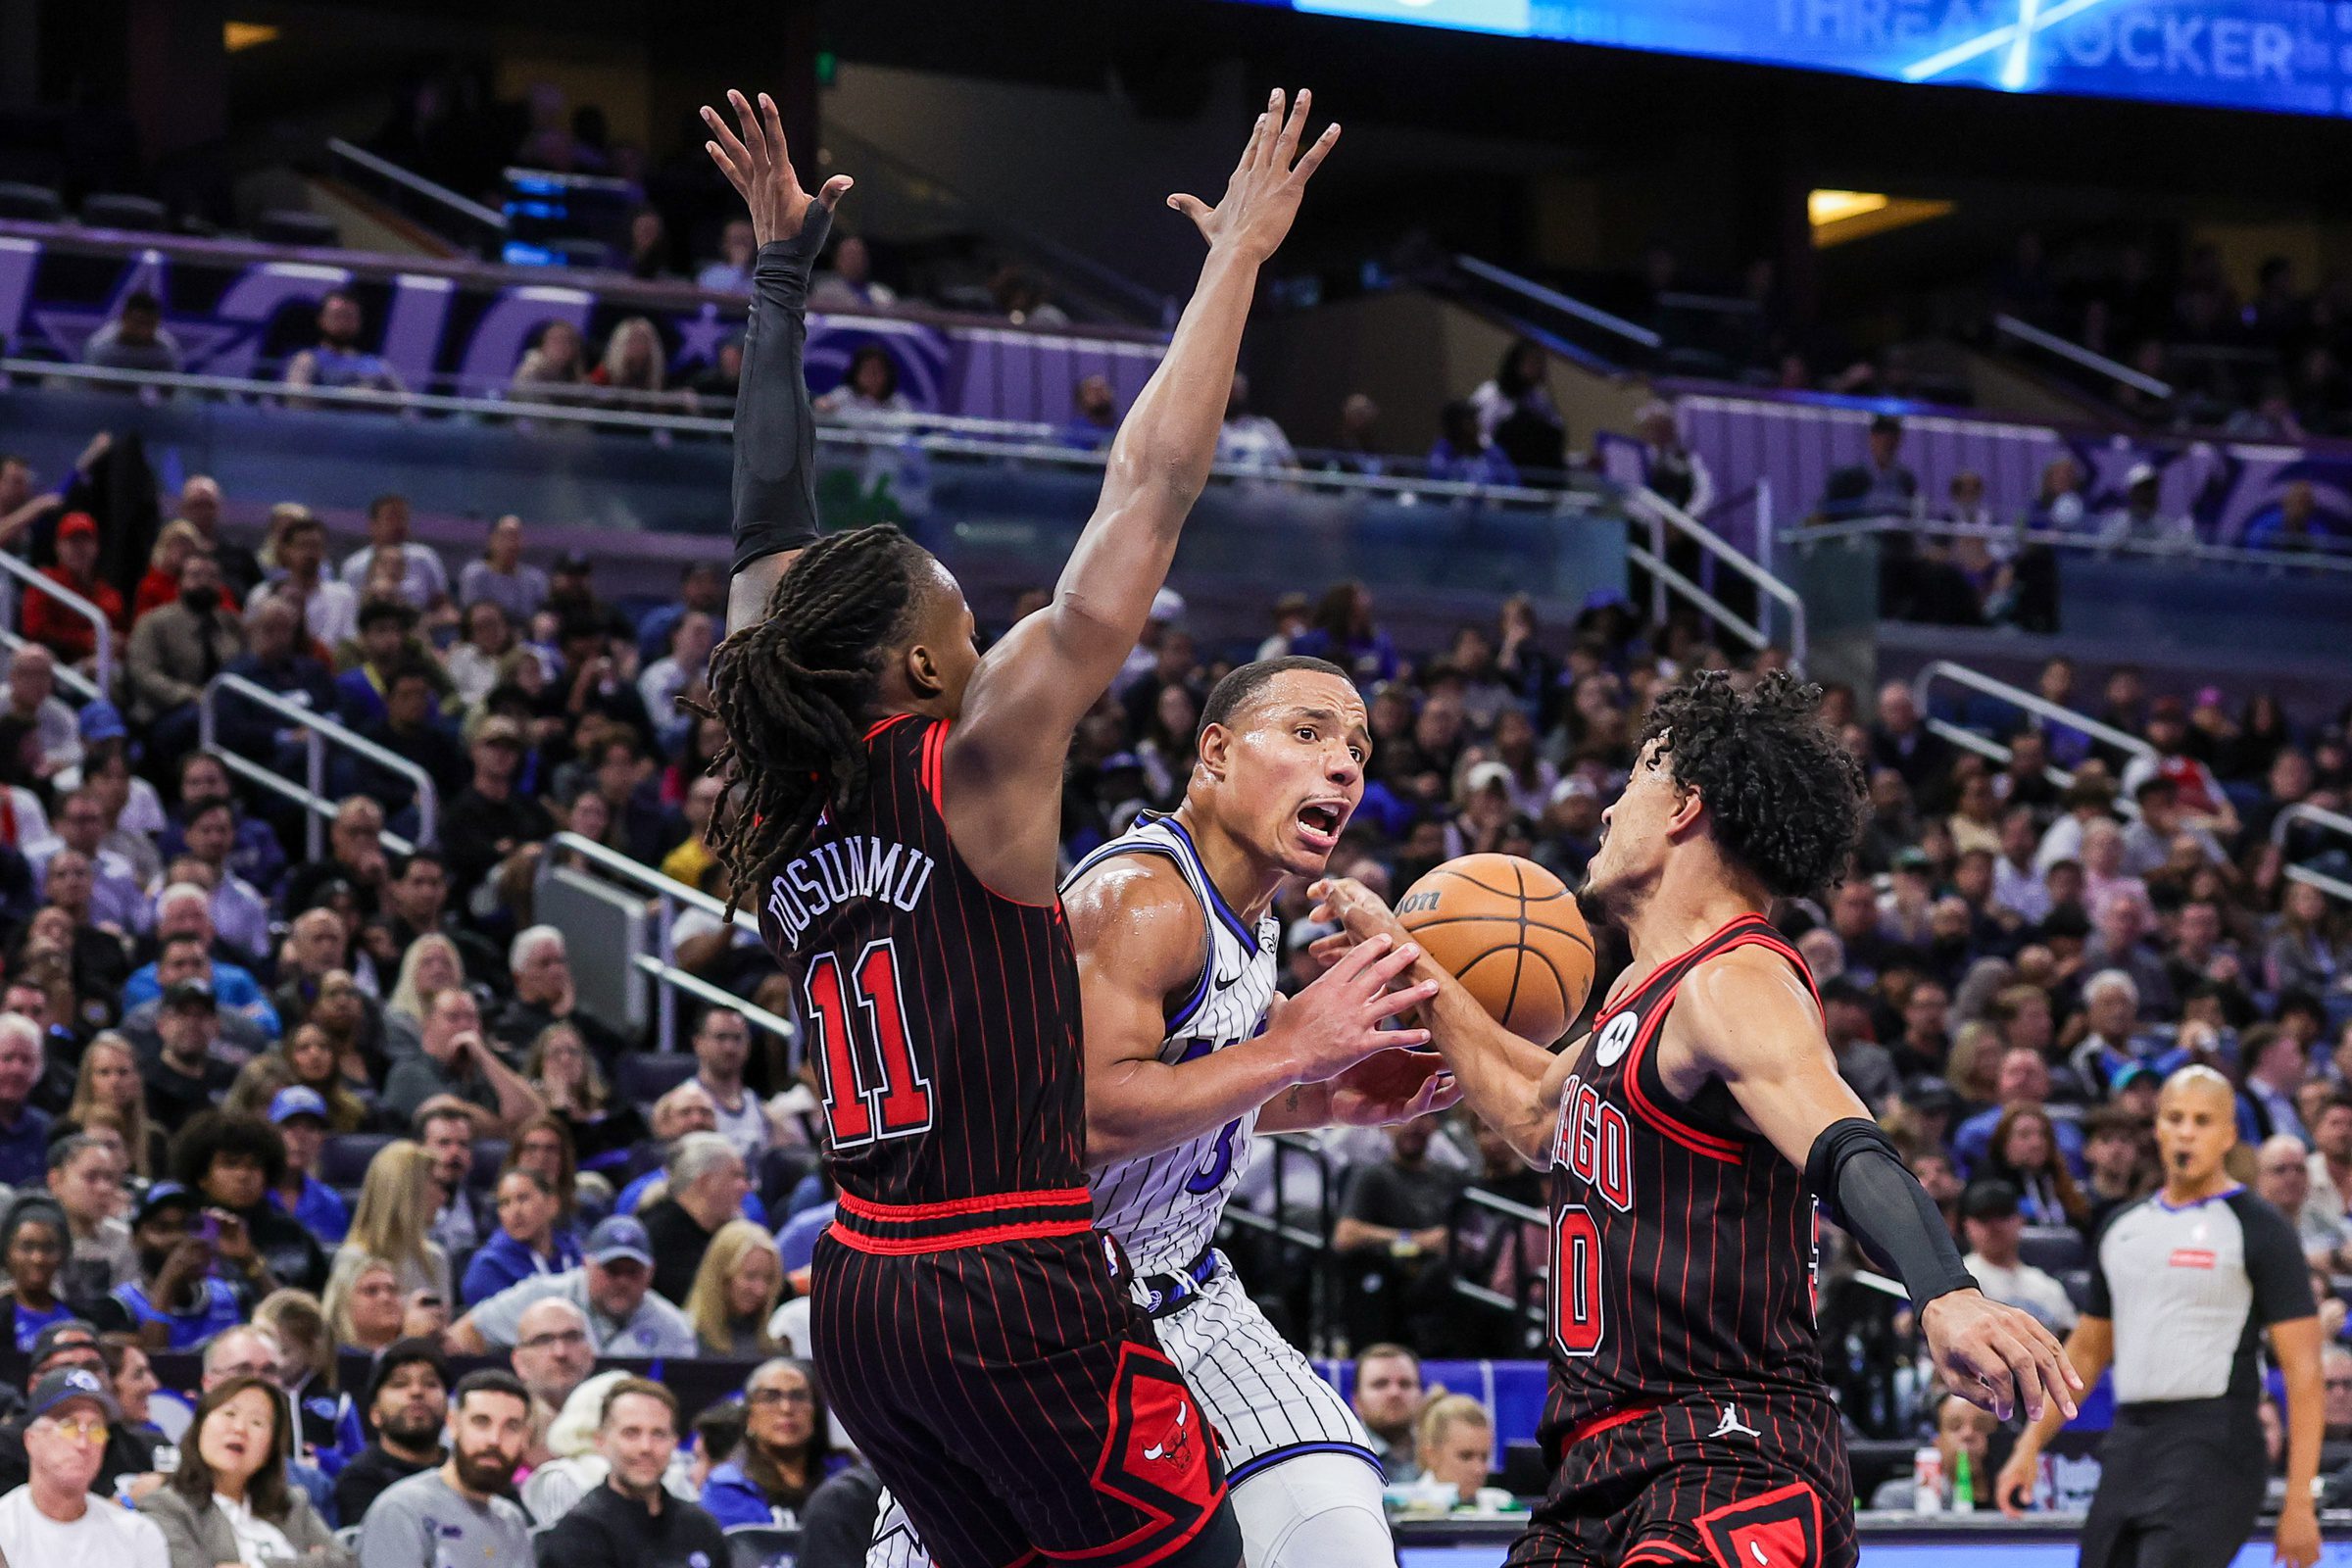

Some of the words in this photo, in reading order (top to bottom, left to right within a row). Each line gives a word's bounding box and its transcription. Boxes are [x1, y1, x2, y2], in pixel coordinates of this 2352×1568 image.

[767, 836, 934, 951] DOSUNMU
[804, 937, 933, 1150] 11
[1546, 1203, 1604, 1358] 0
